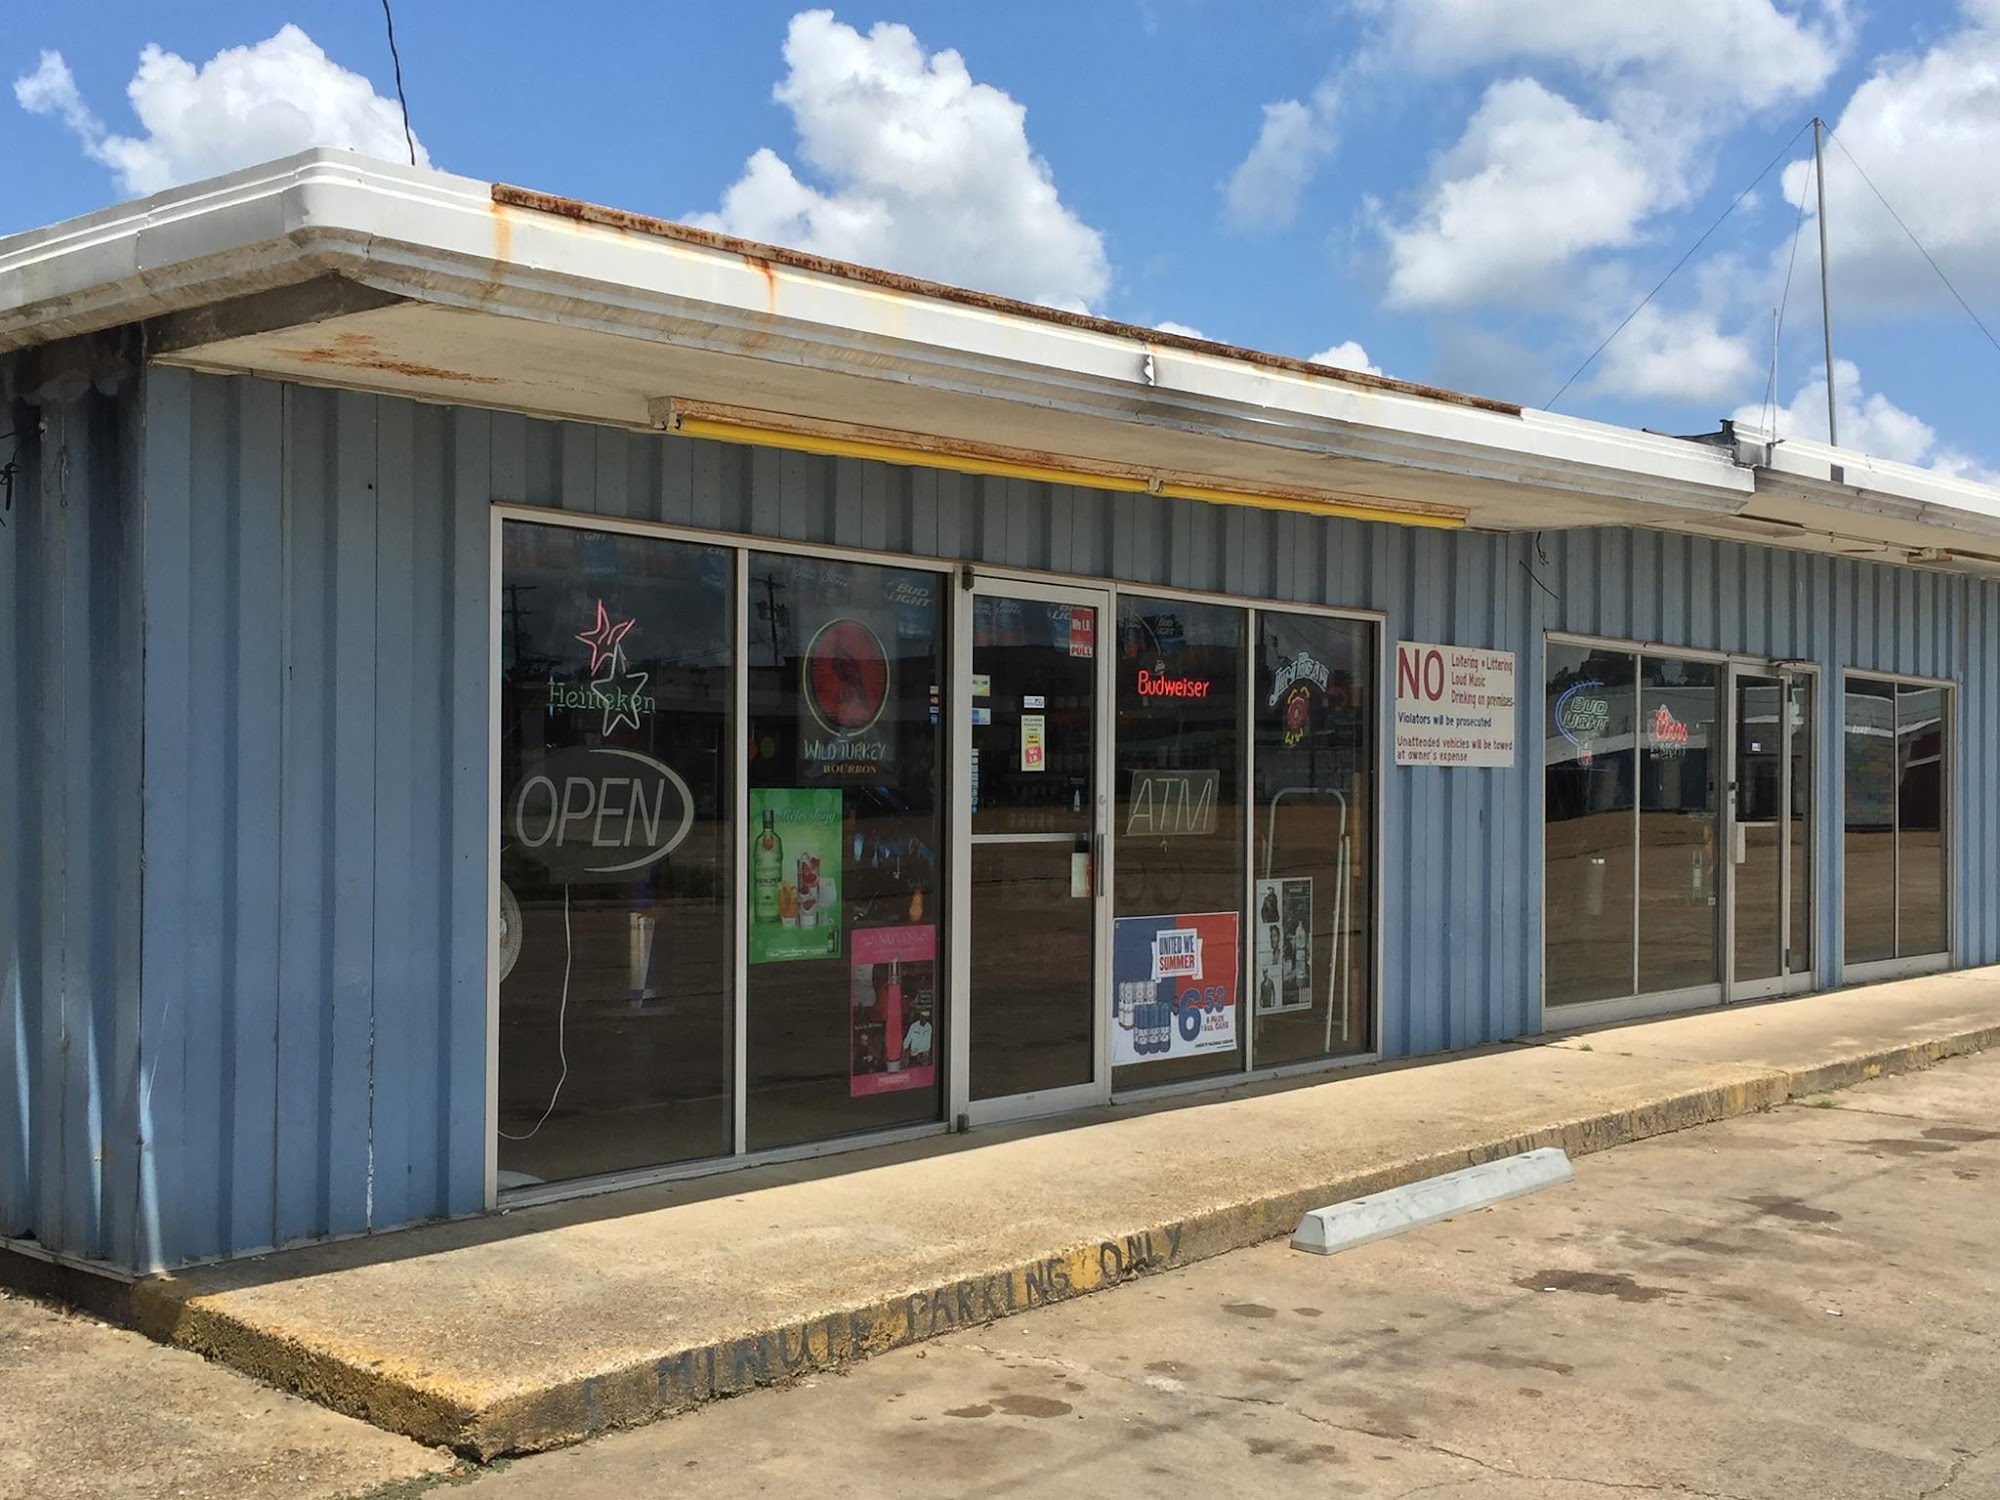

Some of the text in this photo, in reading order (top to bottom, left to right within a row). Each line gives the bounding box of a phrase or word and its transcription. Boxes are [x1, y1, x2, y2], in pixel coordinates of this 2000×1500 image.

[1071, 646, 1092, 656] PULL
[1398, 647, 1444, 701] NO
[1451, 653, 1513, 675] Loitering Littering
[1136, 668, 1211, 697] Budweiser
[1451, 671, 1486, 687] Loud Music
[547, 680, 656, 714] Heineken
[1451, 689, 1513, 709] Drinking on premises
[1570, 696, 1609, 714] BUD
[1397, 712, 1492, 728] Violators will be prosecuted
[803, 738, 887, 761] WILD TURKEY
[1397, 735, 1513, 750] Unattended vehicles will be towed
[1397, 750, 1468, 763] at owner's expense
[822, 763, 877, 774] BOURBON
[516, 775, 665, 847] OPEN
[1126, 778, 1212, 831] ATM
[1159, 935, 1194, 956] UNITED WE
[1159, 954, 1195, 972] SUMMER
[906, 1256, 1071, 1337] PARKING
[1100, 1222, 1182, 1280] ONLY
